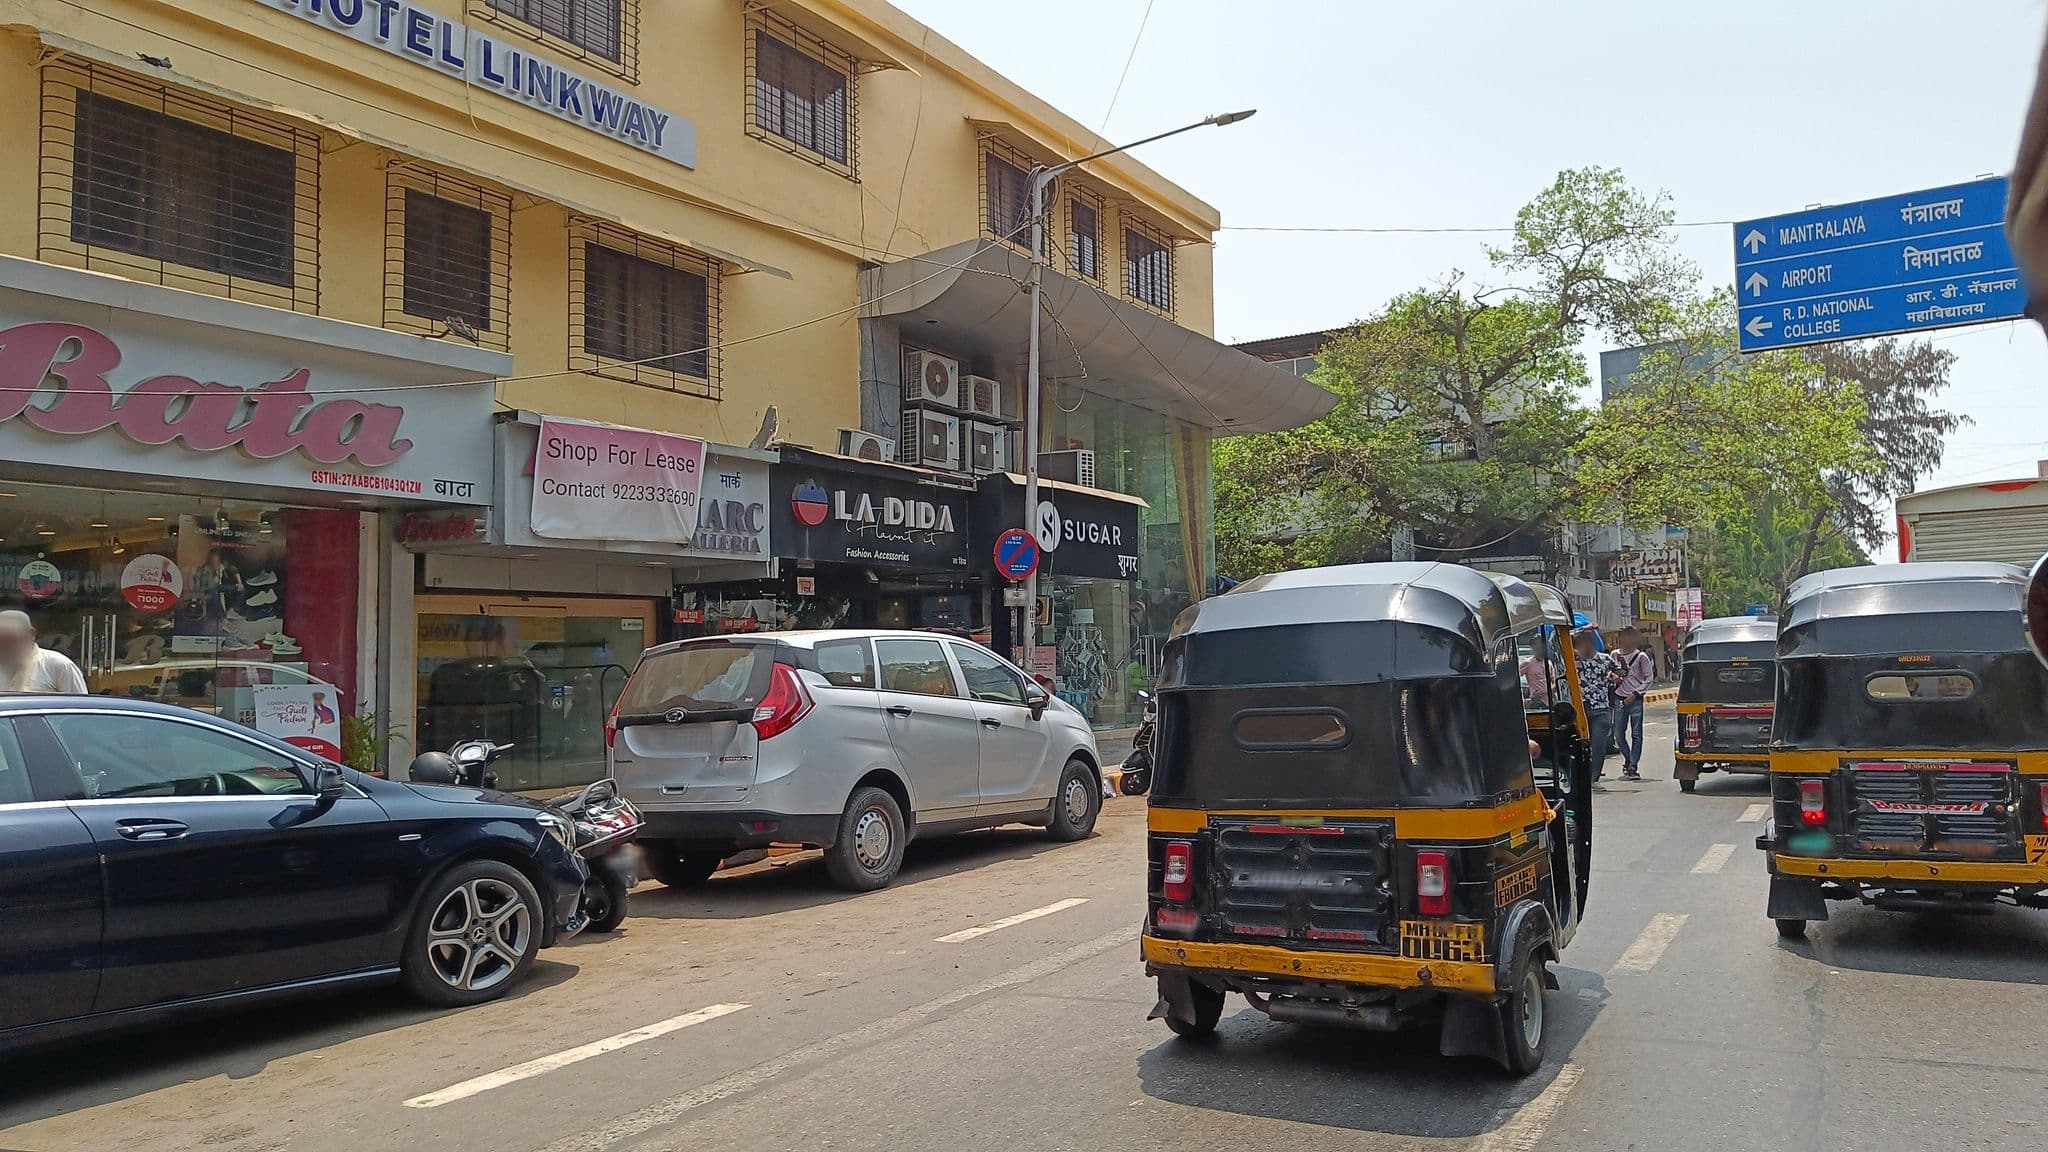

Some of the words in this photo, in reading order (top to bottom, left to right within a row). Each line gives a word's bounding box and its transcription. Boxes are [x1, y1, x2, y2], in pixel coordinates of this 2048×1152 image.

[482, 38, 669, 148] LINKWAY
[1900, 198, 1964, 225] मंत्रालय
[1779, 215, 1866, 246] MANTRALAYA
[1902, 241, 1984, 272] विमानतळ
[1781, 264, 1833, 289] AIRPORT
[1905, 290, 1936, 303] आर.
[1940, 283, 1964, 299] डी.
[1783, 307, 1795, 321] R.
[1797, 305, 1810, 319] D.
[1812, 296, 1874, 317] NATIONAL
[1905, 302, 1986, 322] महाविद्यालय
[1783, 318, 1841, 339] COLLEGE
[0, 320, 415, 468] Bata
[546, 438, 598, 465] Shop
[608, 444, 637, 466] For
[644, 448, 696, 474] Lease
[433, 479, 475, 498] बाटा
[542, 478, 605, 499] Contact
[612, 484, 695, 507] 9223333690
[720, 471, 741, 489] मार्क
[697, 497, 765, 533] ARC
[834, 489, 876, 523] LA
[883, 496, 956, 533] DIDA
[692, 531, 761, 553] ALLERIA
[1064, 519, 1122, 546] SUGAR
[846, 547, 873, 559] Fashion
[873, 550, 910, 562] Accessories
[1117, 554, 1138, 577] शुगर
